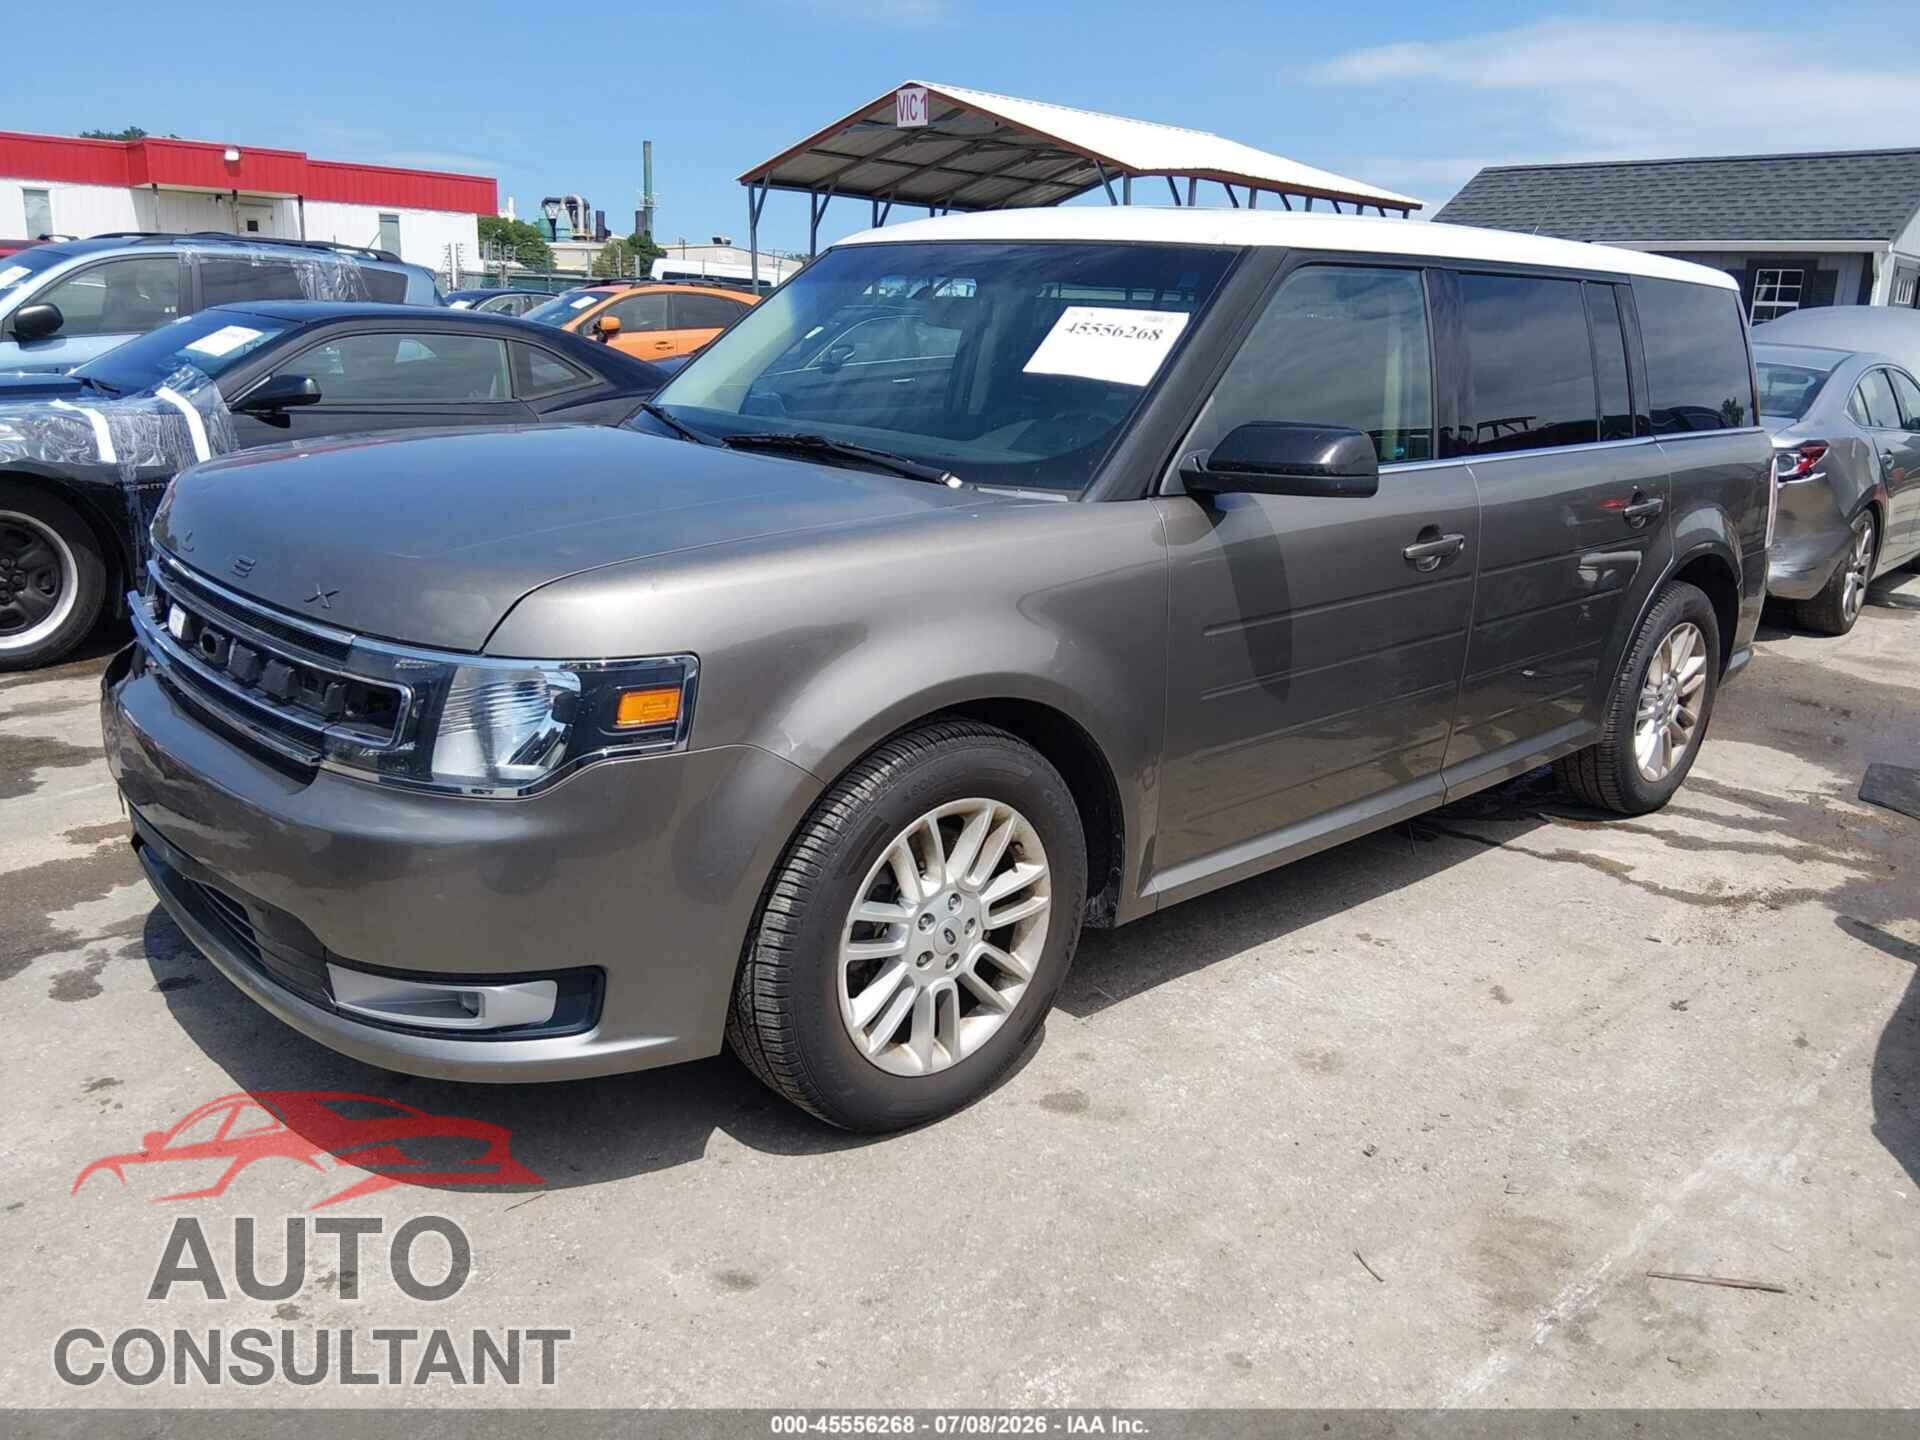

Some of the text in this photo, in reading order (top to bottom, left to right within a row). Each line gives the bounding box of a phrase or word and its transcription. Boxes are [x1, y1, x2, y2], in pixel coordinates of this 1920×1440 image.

[897, 94, 928, 121] VIC 1
[1065, 322, 1163, 342] 45556268
